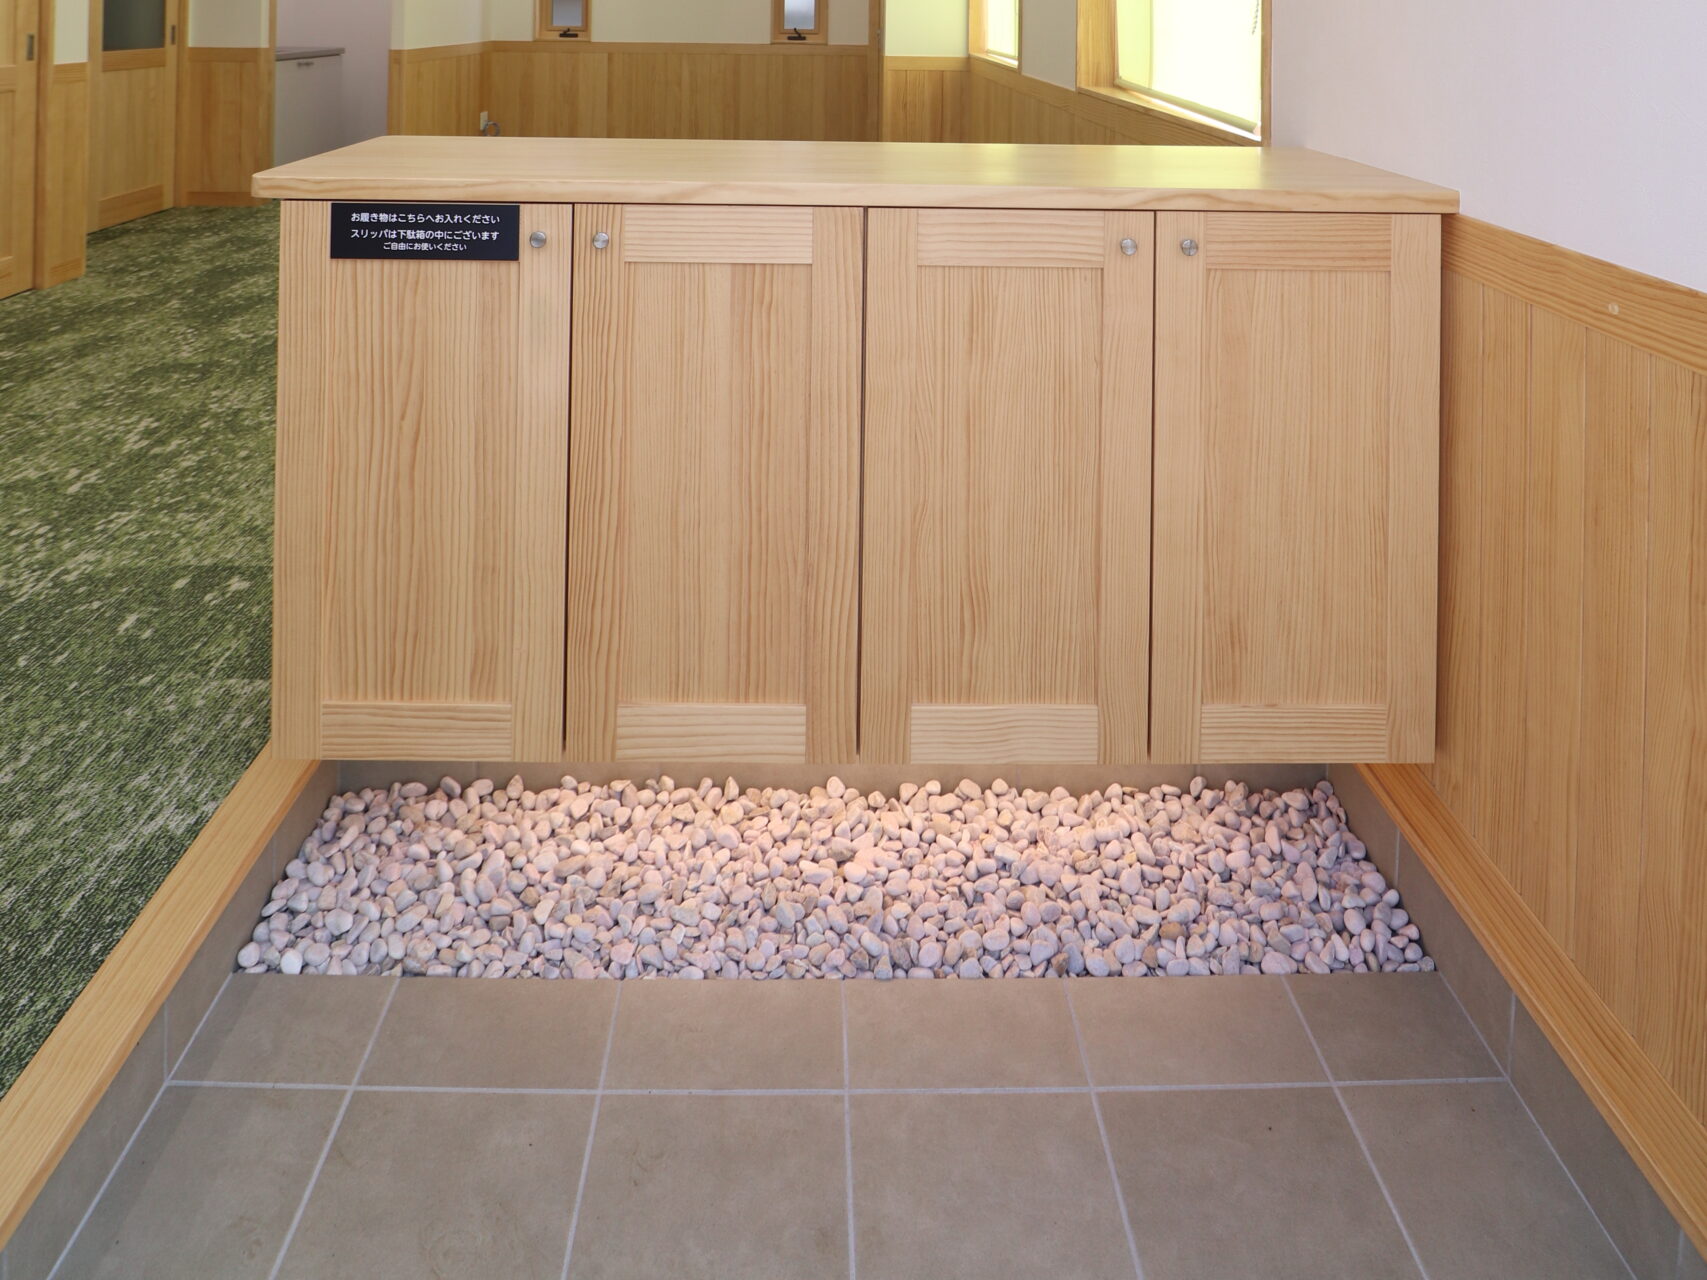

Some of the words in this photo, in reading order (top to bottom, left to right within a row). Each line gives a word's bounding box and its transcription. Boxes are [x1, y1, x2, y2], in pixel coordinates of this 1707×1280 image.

[350, 212, 500, 224] お履き物はこちらへお入れください
[350, 229, 500, 241] スリッパは下駄箱の中にございます
[383, 242, 467, 251] ご自由にお使いください
